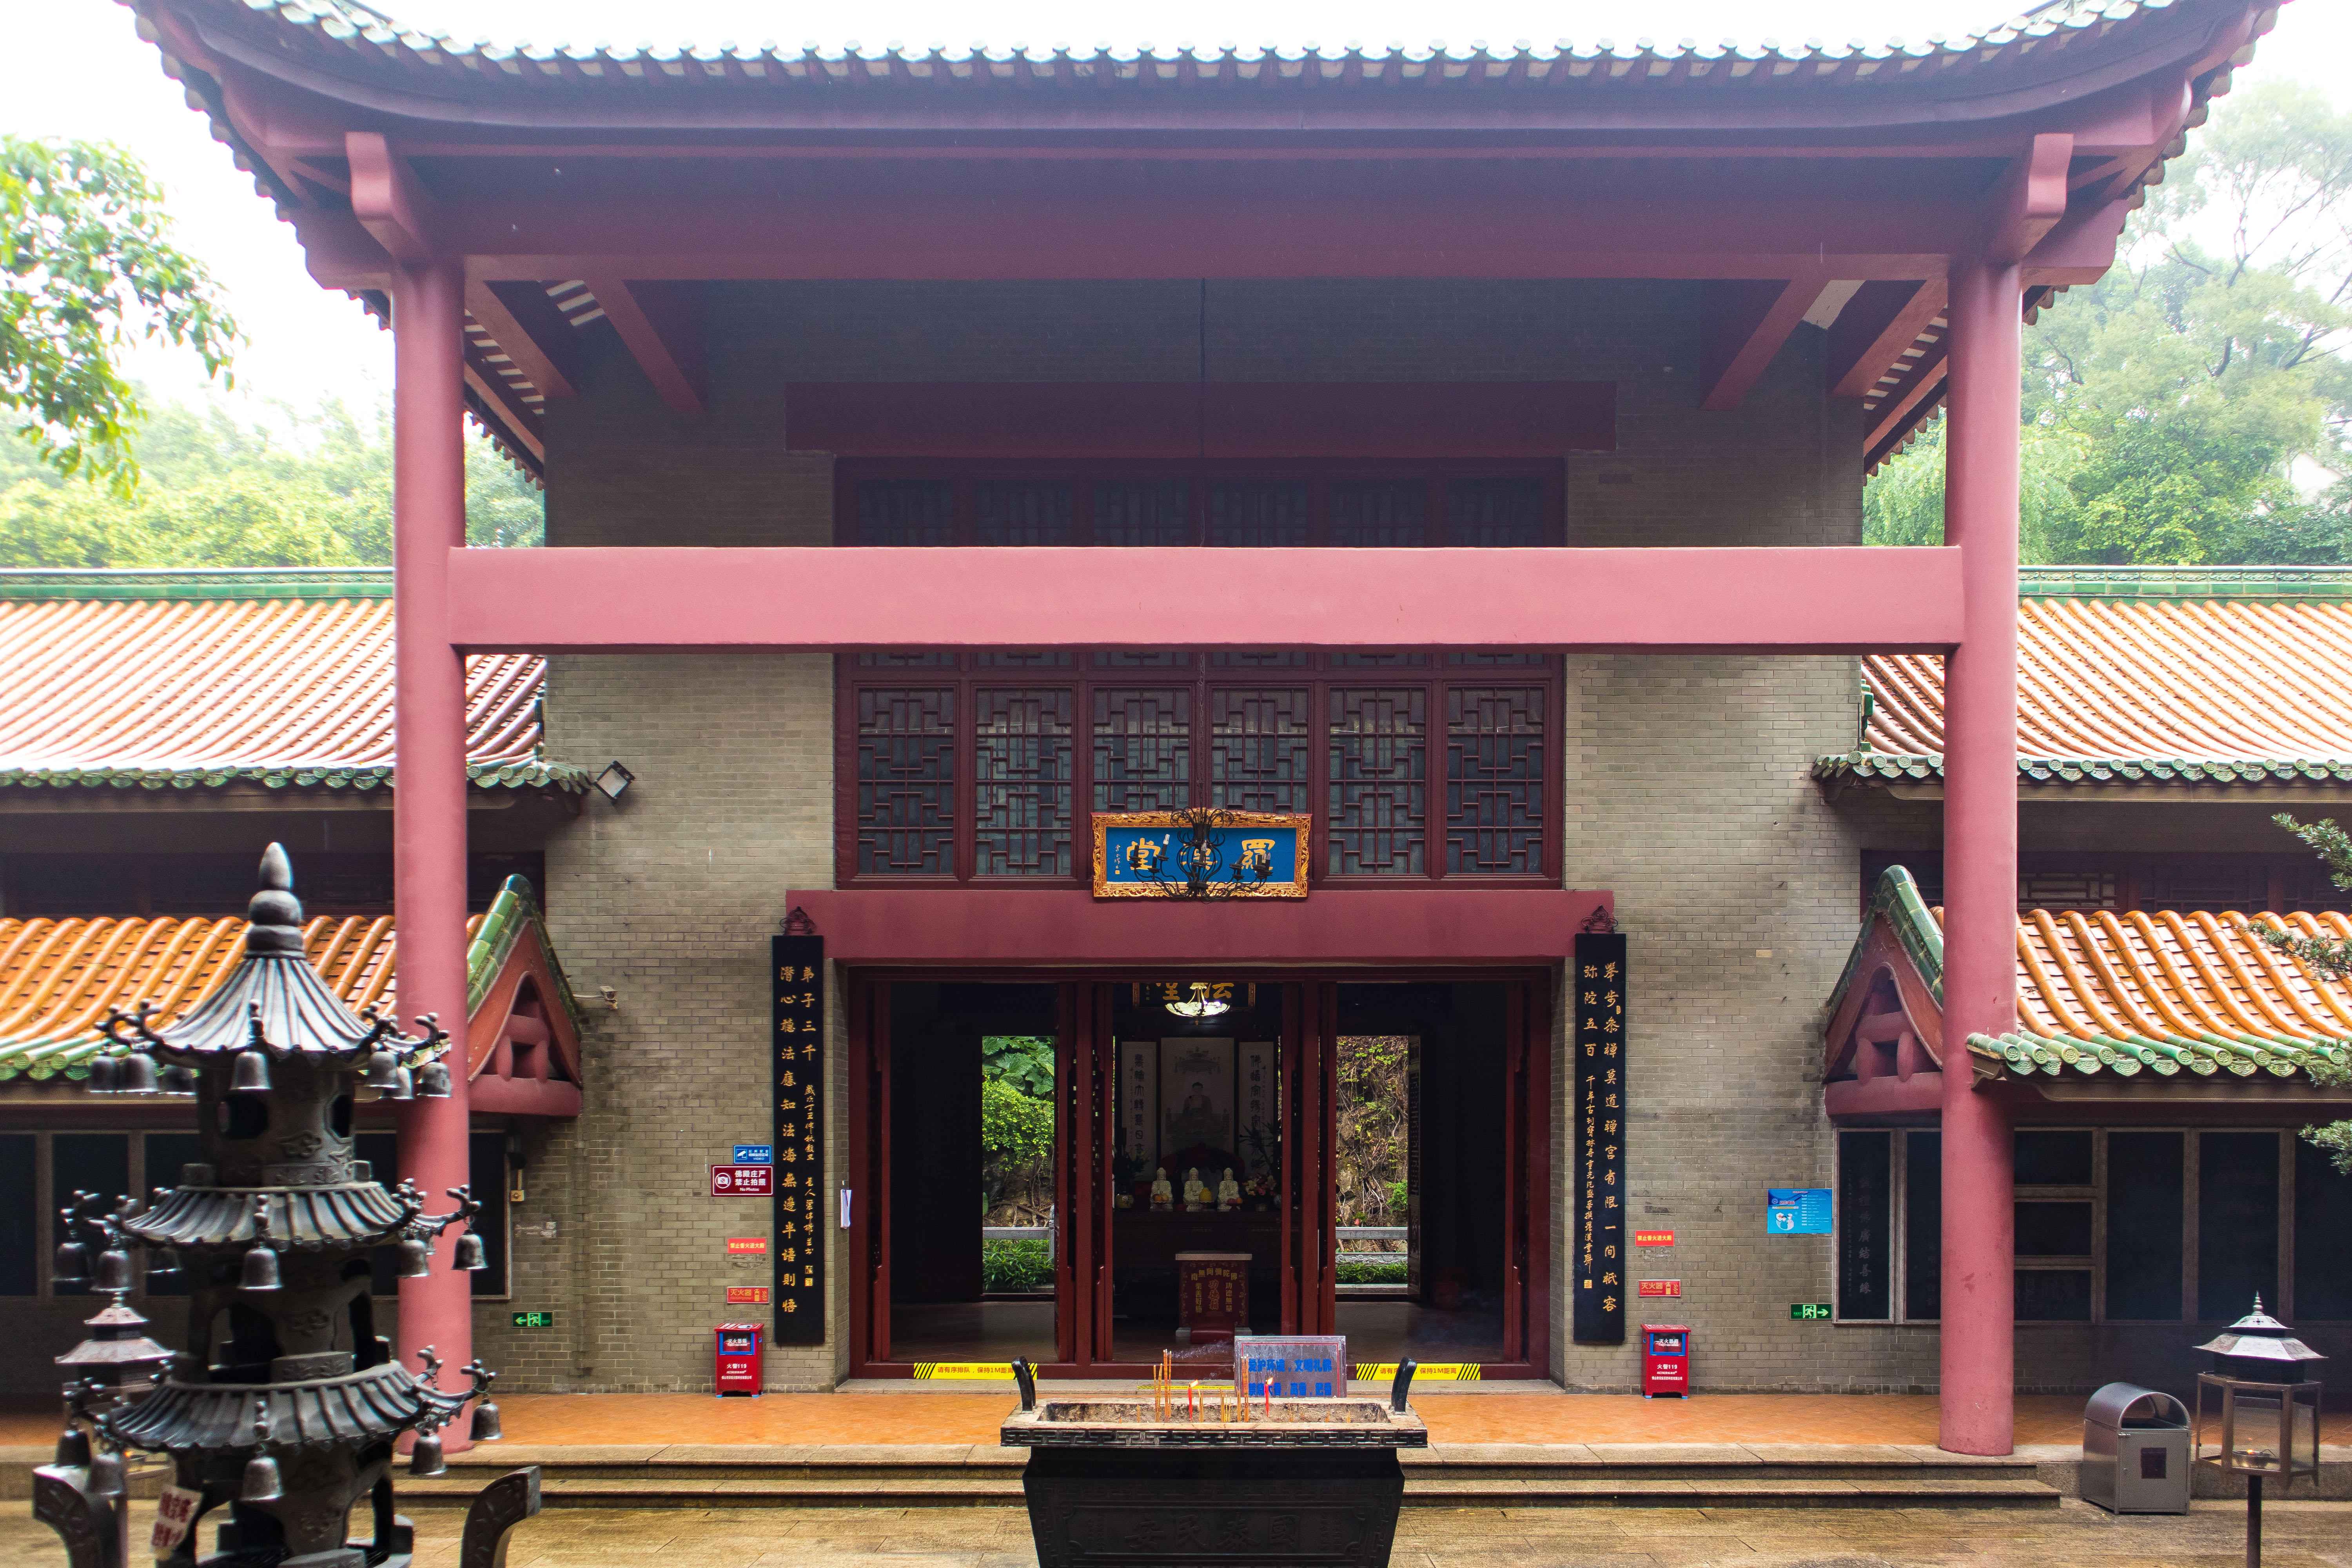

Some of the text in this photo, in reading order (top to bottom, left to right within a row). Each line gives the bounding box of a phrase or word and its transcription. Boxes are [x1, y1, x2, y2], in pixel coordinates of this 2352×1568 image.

[800, 966, 816, 1061] 弟子三千
[1124, 1512, 1301, 1552] 國泰民安
